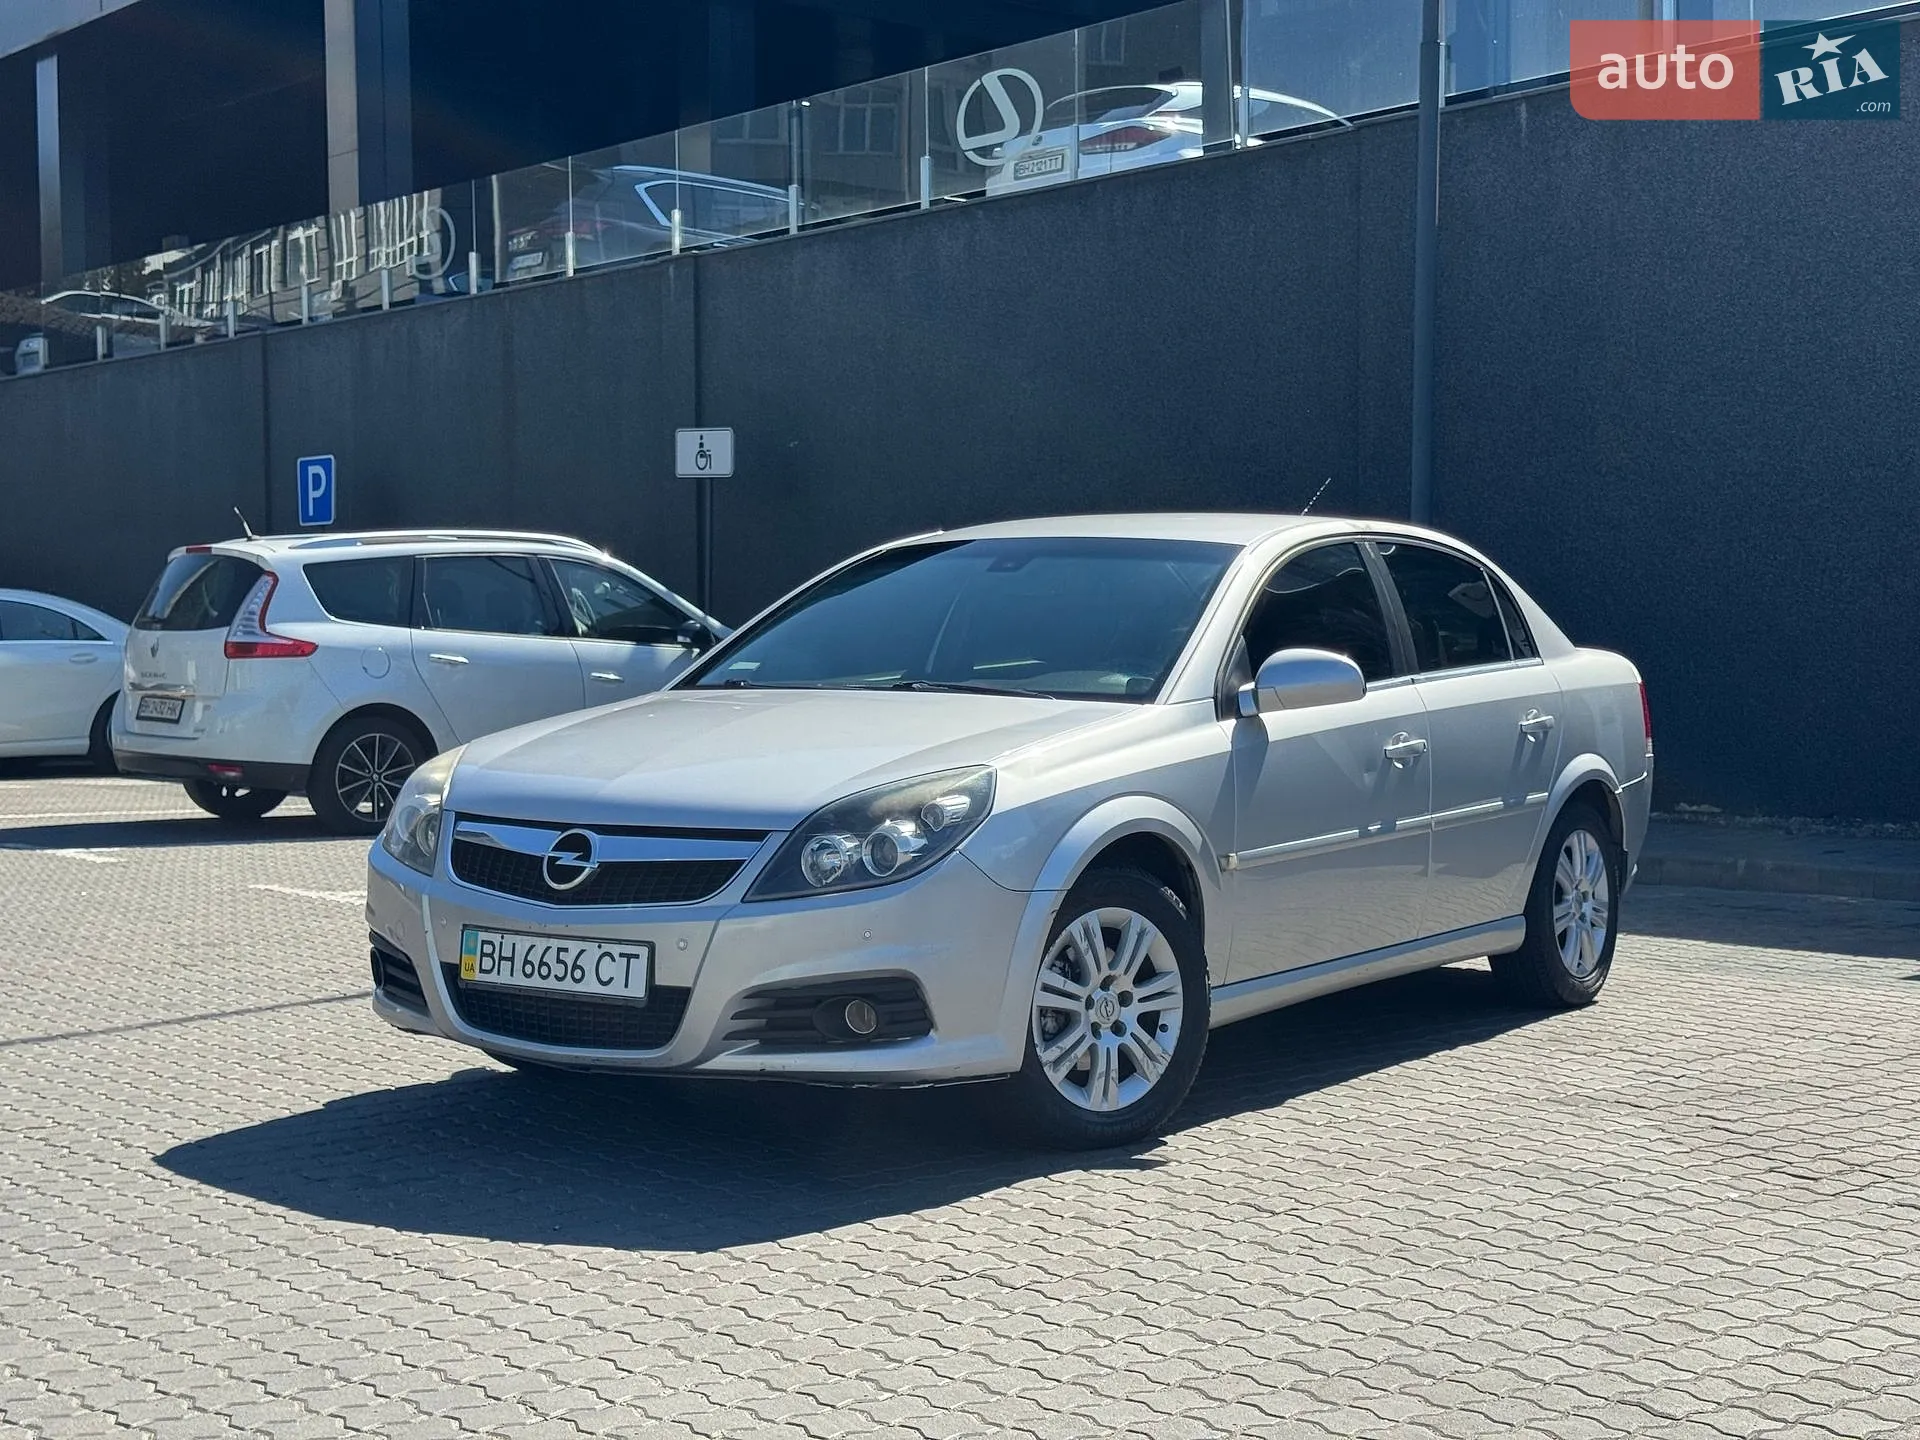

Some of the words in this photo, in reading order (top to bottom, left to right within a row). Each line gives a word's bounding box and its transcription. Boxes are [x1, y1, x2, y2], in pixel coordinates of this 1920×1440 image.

[308, 465, 327, 516] P
[464, 961, 475, 973] UA
[479, 939, 516, 977] BH
[521, 944, 587, 984] 6656
[595, 951, 640, 989] CT
